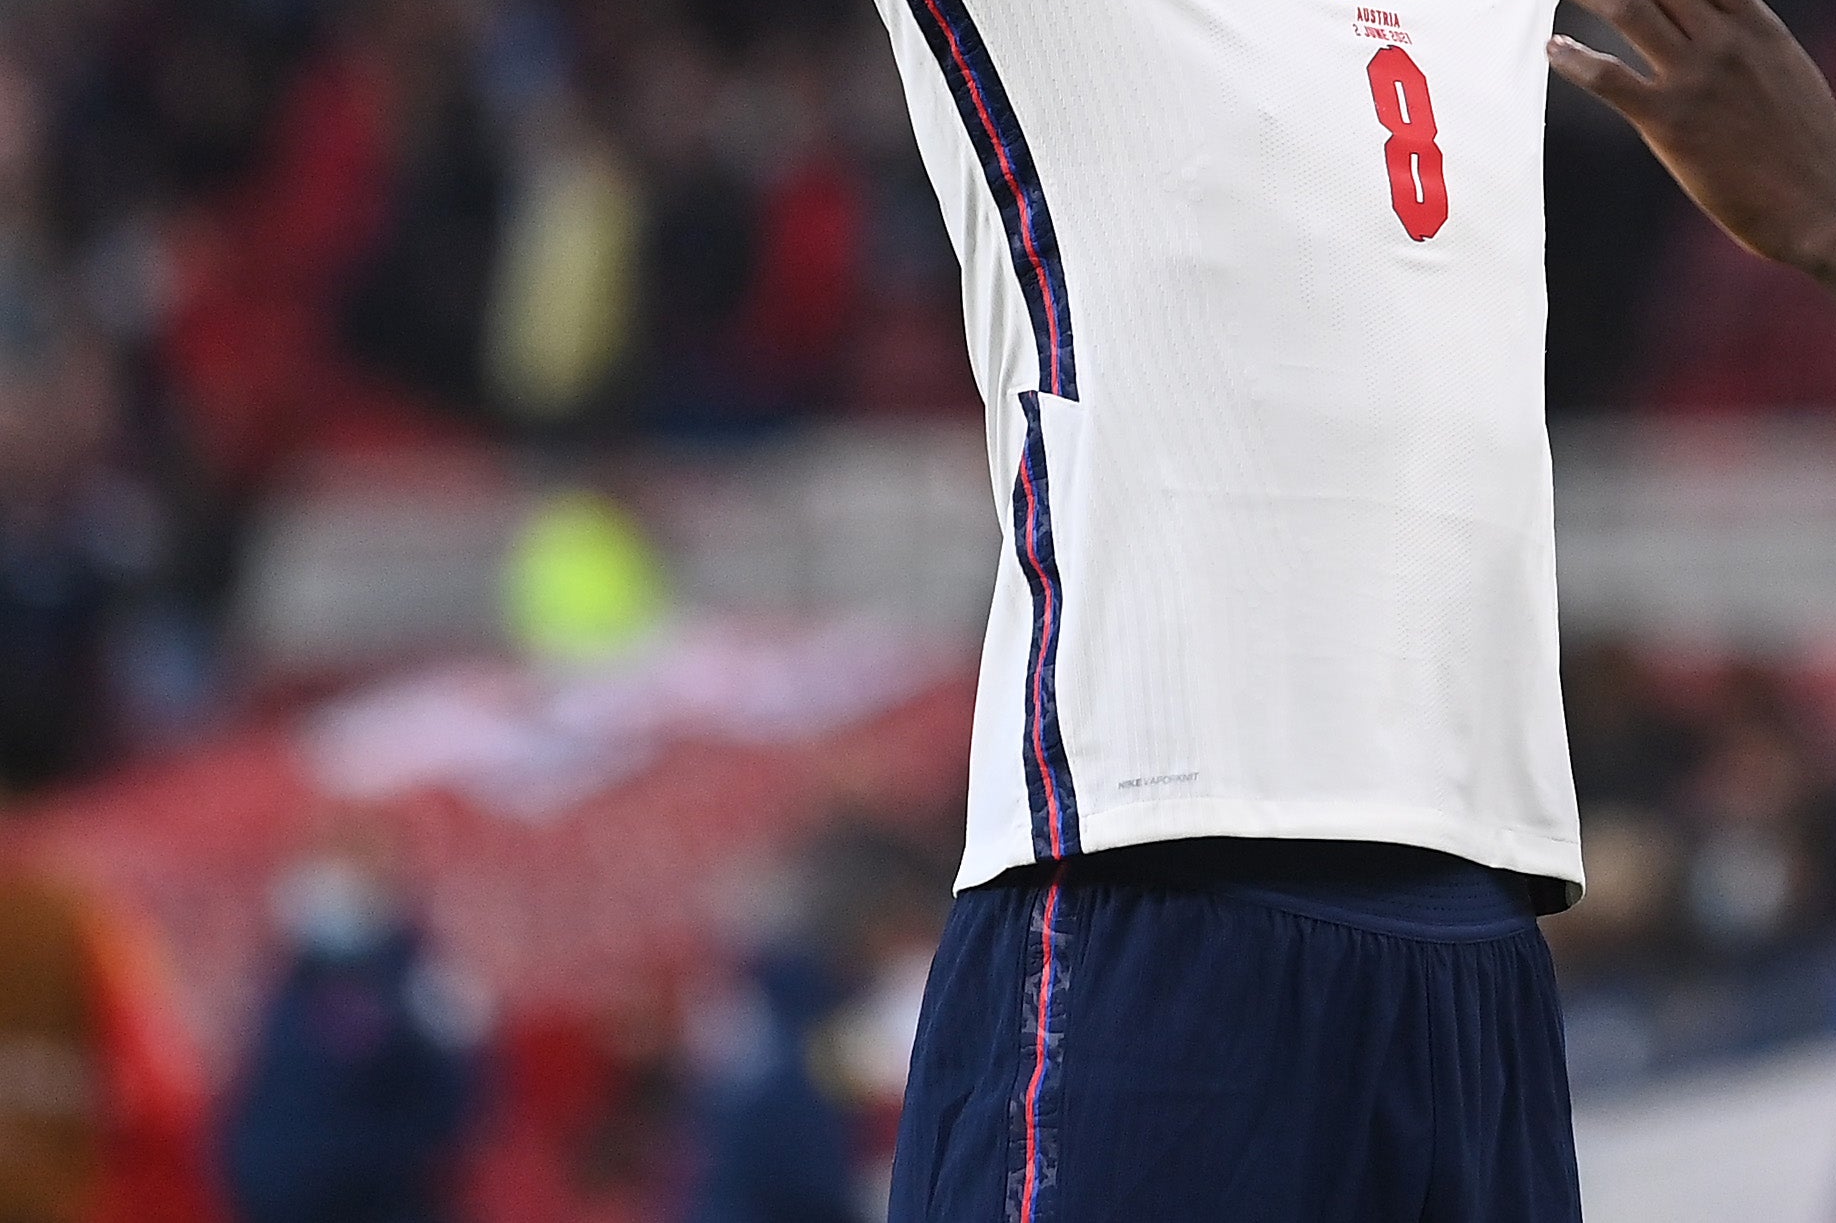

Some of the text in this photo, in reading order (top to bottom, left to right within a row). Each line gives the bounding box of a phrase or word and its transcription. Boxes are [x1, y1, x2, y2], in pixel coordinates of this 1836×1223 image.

[1357, 7, 1400, 28] AUSTRIA
[1352, 23, 1361, 36] 2
[1367, 45, 1448, 242] 8
